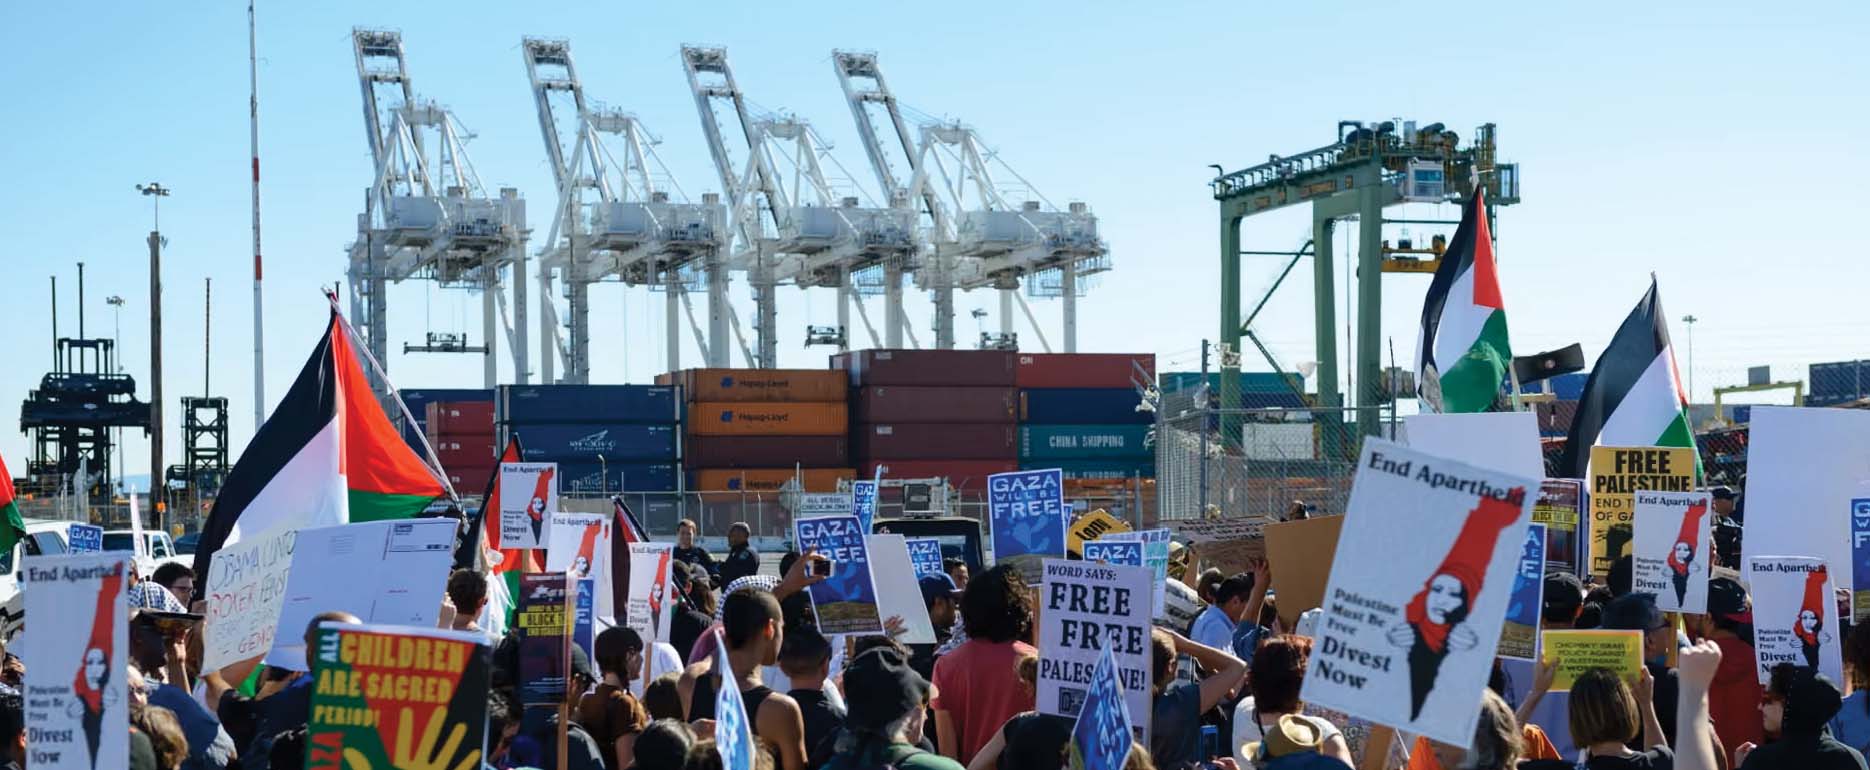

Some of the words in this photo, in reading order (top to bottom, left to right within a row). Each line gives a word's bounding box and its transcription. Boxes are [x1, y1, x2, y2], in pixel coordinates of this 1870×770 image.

[1049, 435, 1077, 448] CHINA
[1083, 435, 1124, 448] SHIPPING
[1368, 452, 1413, 478] End
[1615, 450, 1671, 474] FREE
[856, 485, 875, 496] GAZ
[992, 474, 1058, 493] GAZA
[1595, 475, 1690, 493] PALESTINE
[994, 491, 1033, 502] WILL
[1040, 489, 1057, 498] BE
[1596, 498, 1622, 508] END
[1638, 496, 1657, 504] End
[994, 499, 1060, 520] FREE
[1595, 511, 1614, 521] OF
[72, 528, 100, 540] GAZA
[800, 520, 858, 540] GAZA
[819, 546, 866, 563] REE
[911, 542, 939, 553] AZA
[1086, 545, 1139, 560] GAZA
[30, 567, 58, 581] End
[912, 562, 941, 574] REE
[1047, 565, 1083, 578] WORD
[1084, 568, 1117, 580] SAYS:
[1752, 562, 1773, 572] End
[1636, 579, 1667, 589] Divest
[1048, 582, 1131, 617] FREE
[1334, 588, 1399, 615] Palestine
[1332, 603, 1364, 623] Must
[1368, 613, 1386, 628] Be
[1327, 617, 1357, 635] Free
[1060, 619, 1144, 655] FREE
[320, 633, 340, 662] ALL
[340, 633, 465, 673] CHILDREN
[1321, 636, 1392, 672] Divest
[1760, 652, 1797, 661] Divest
[1040, 658, 1146, 691] PALESNE!
[1315, 659, 1368, 690] Now
[317, 668, 362, 697] ARE
[366, 671, 452, 705] SACRED
[313, 705, 381, 728] PERIOD!
[29, 727, 73, 743] Divest
